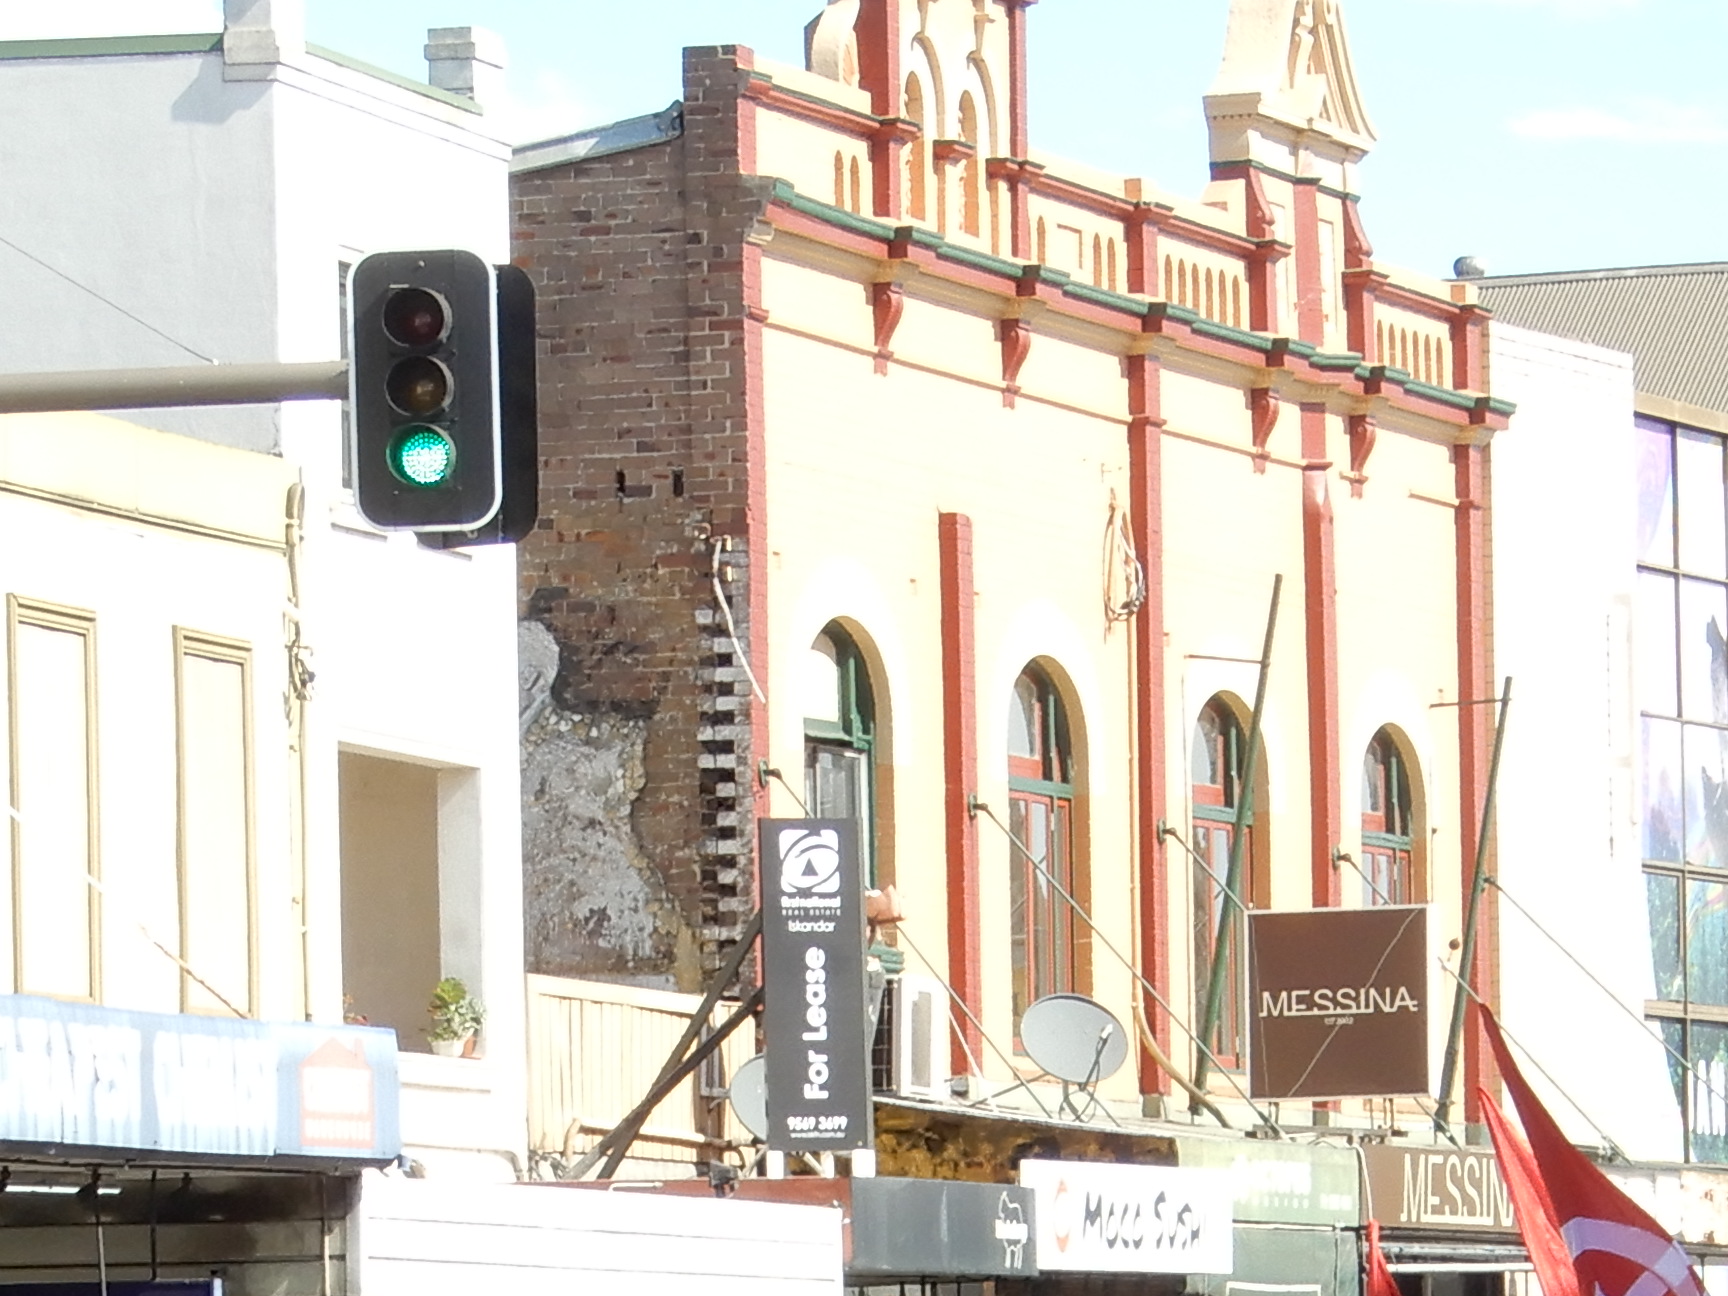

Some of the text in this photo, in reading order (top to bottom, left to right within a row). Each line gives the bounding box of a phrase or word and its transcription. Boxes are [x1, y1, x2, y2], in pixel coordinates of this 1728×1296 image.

[802, 946, 828, 1041] Lease
[1259, 986, 1419, 1017] MESSINA
[803, 1050, 829, 1100] For
[1400, 1153, 1514, 1227] MESSIN
